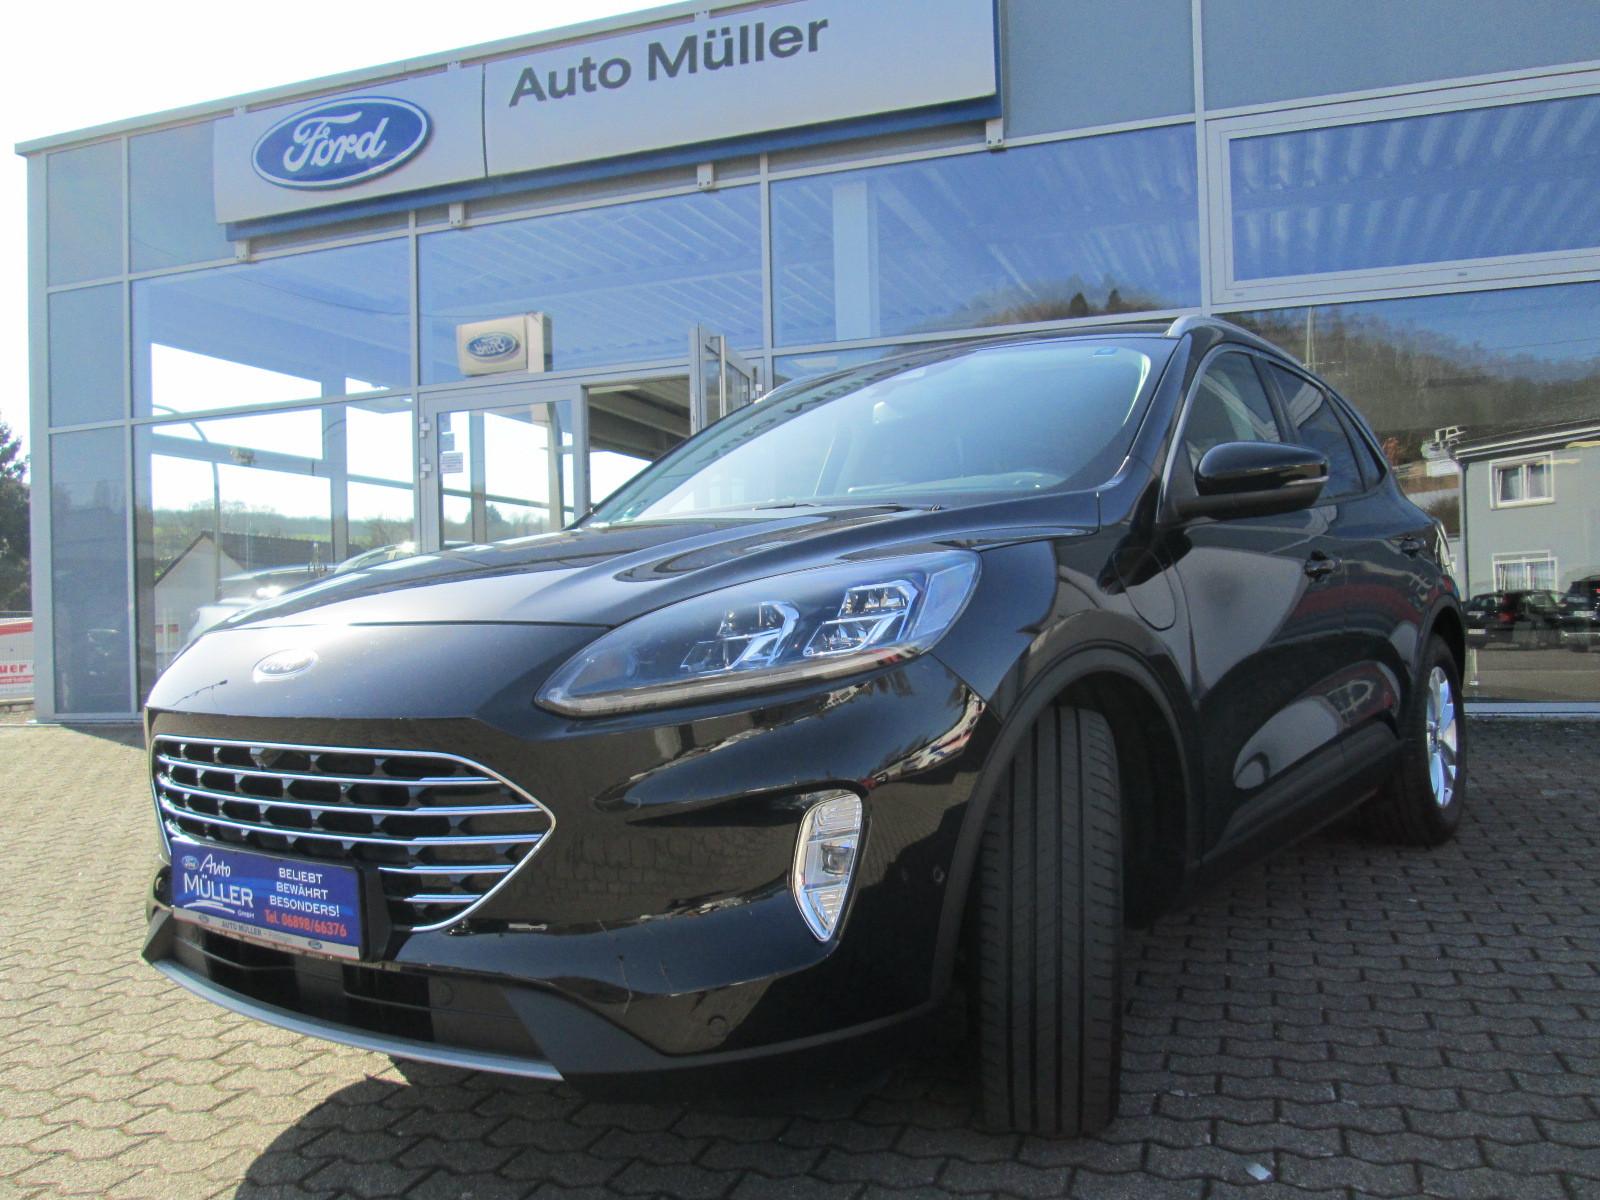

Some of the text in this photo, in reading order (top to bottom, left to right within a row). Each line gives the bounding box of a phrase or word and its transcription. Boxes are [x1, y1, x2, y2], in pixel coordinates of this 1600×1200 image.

[509, 18, 829, 108] Auto Müller
[282, 110, 390, 173] Ford
[199, 853, 231, 878] Auto
[278, 867, 323, 885] BELIEBT
[183, 872, 255, 909] MÜLLER
[275, 881, 329, 901] BEWÄHRT
[269, 894, 341, 918] BESONDERS!
